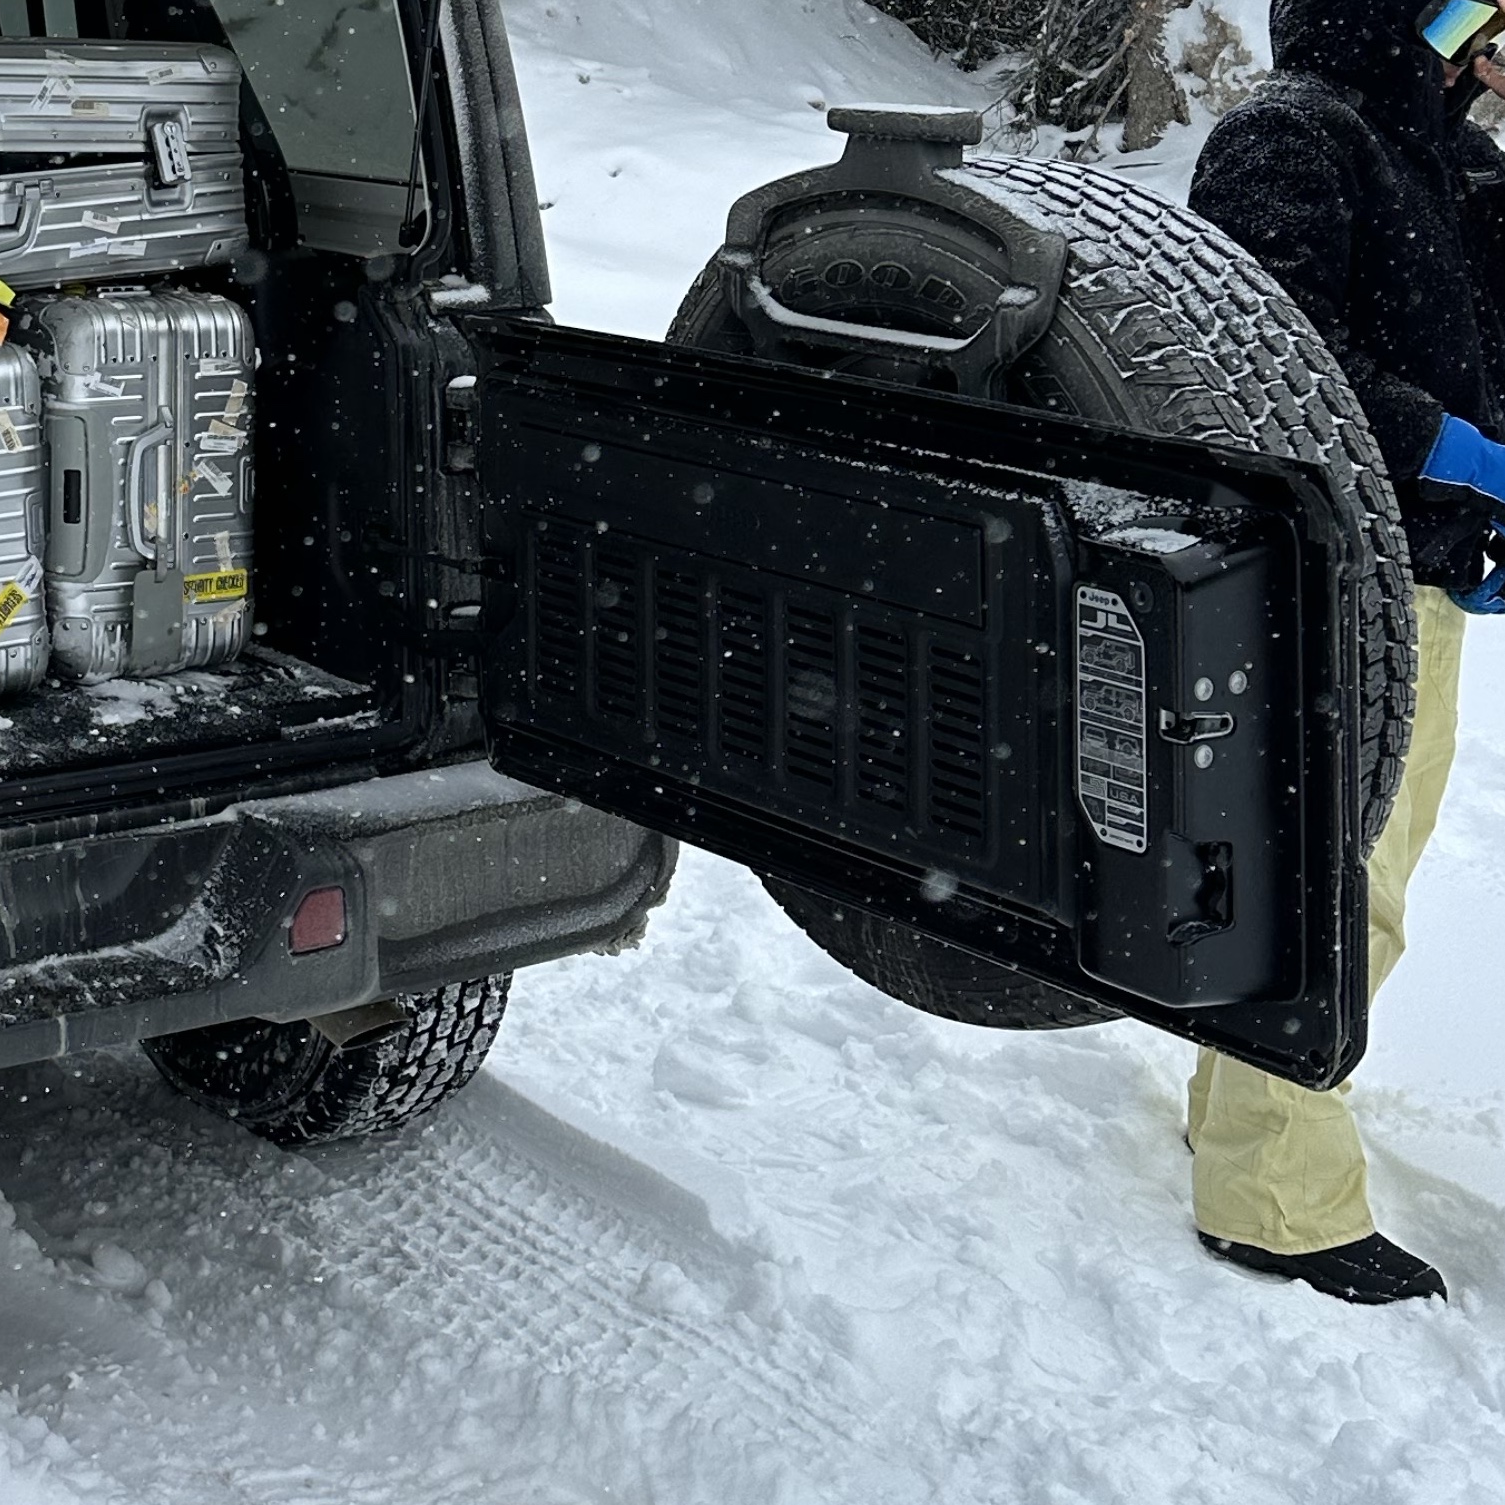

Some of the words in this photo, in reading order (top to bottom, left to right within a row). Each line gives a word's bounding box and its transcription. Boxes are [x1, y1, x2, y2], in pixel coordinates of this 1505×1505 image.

[1088, 592, 1110, 606] Jeep
[1081, 610, 1133, 632] JL
[1109, 788, 1140, 805] USA
